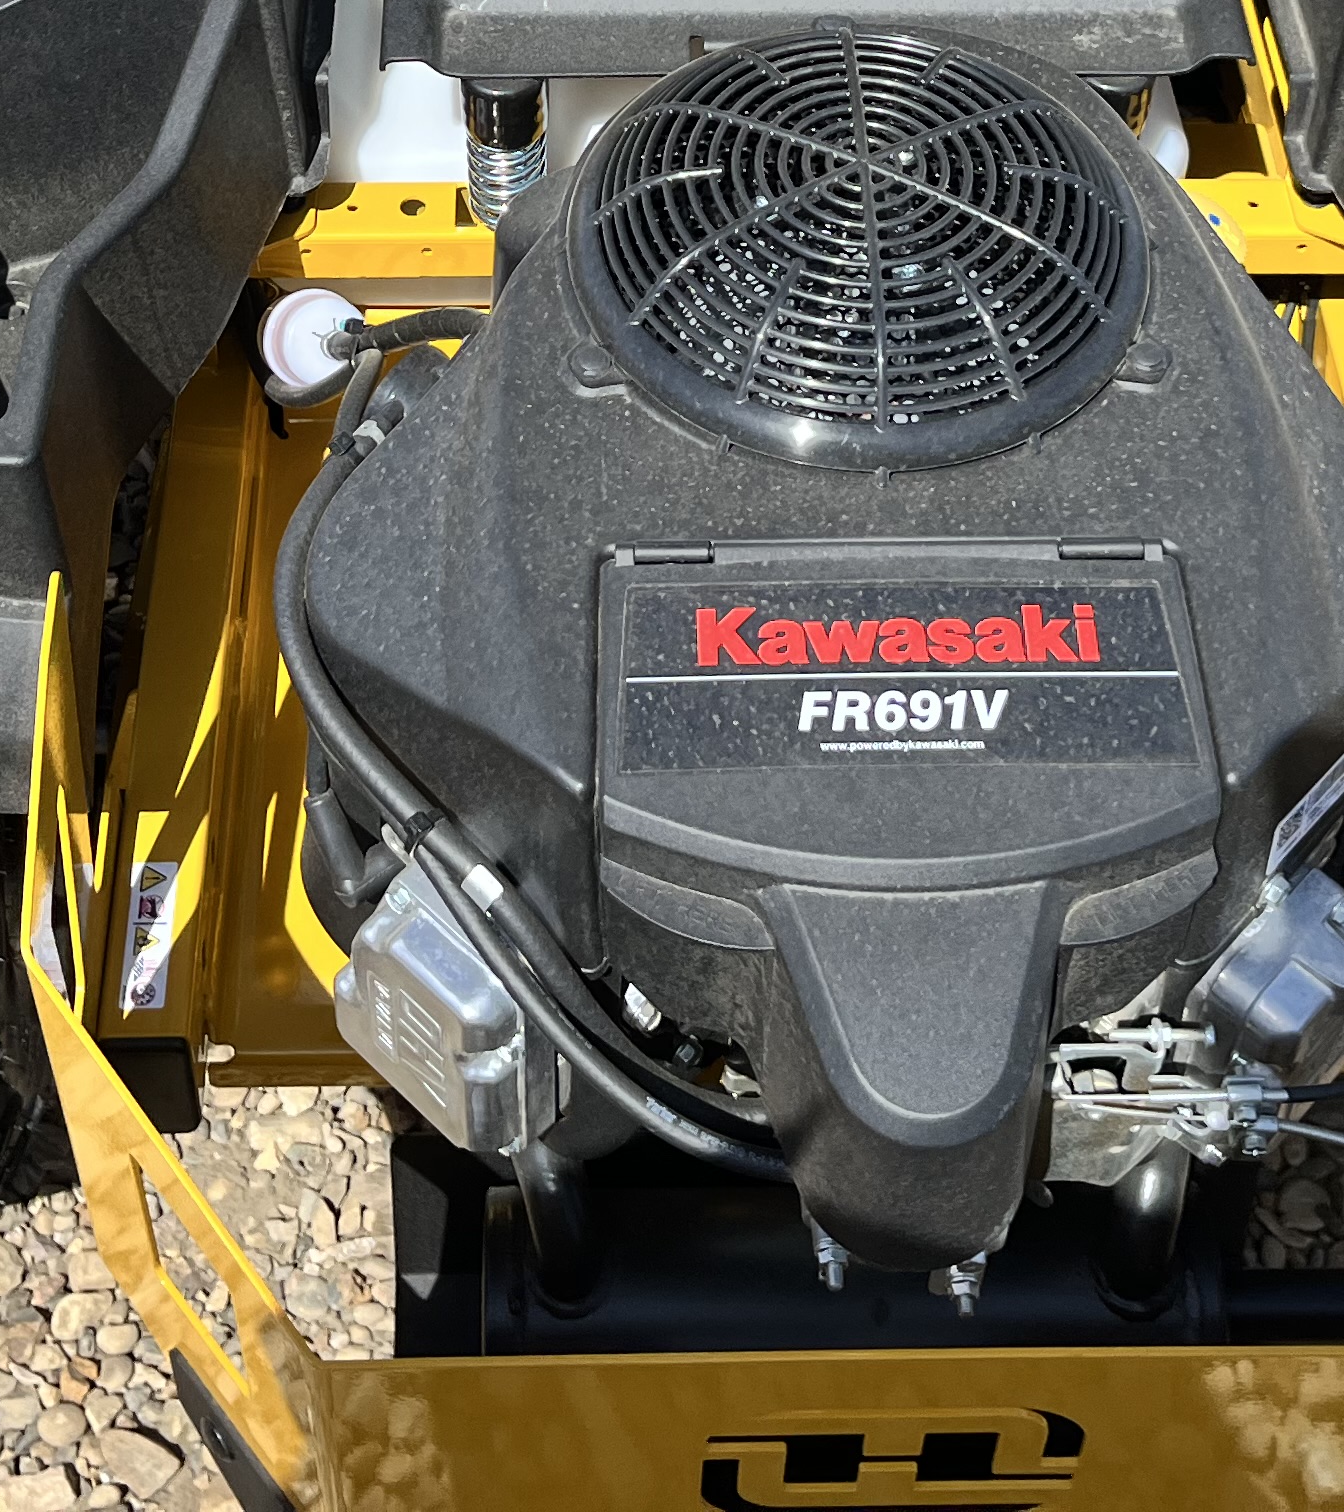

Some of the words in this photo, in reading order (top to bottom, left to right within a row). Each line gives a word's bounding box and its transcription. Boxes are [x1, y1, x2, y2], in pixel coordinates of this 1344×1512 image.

[695, 603, 1101, 667] Kawasaki
[798, 688, 1009, 733] FR691V
[820, 738, 985, 753] www.poweredbykawasaki.com
